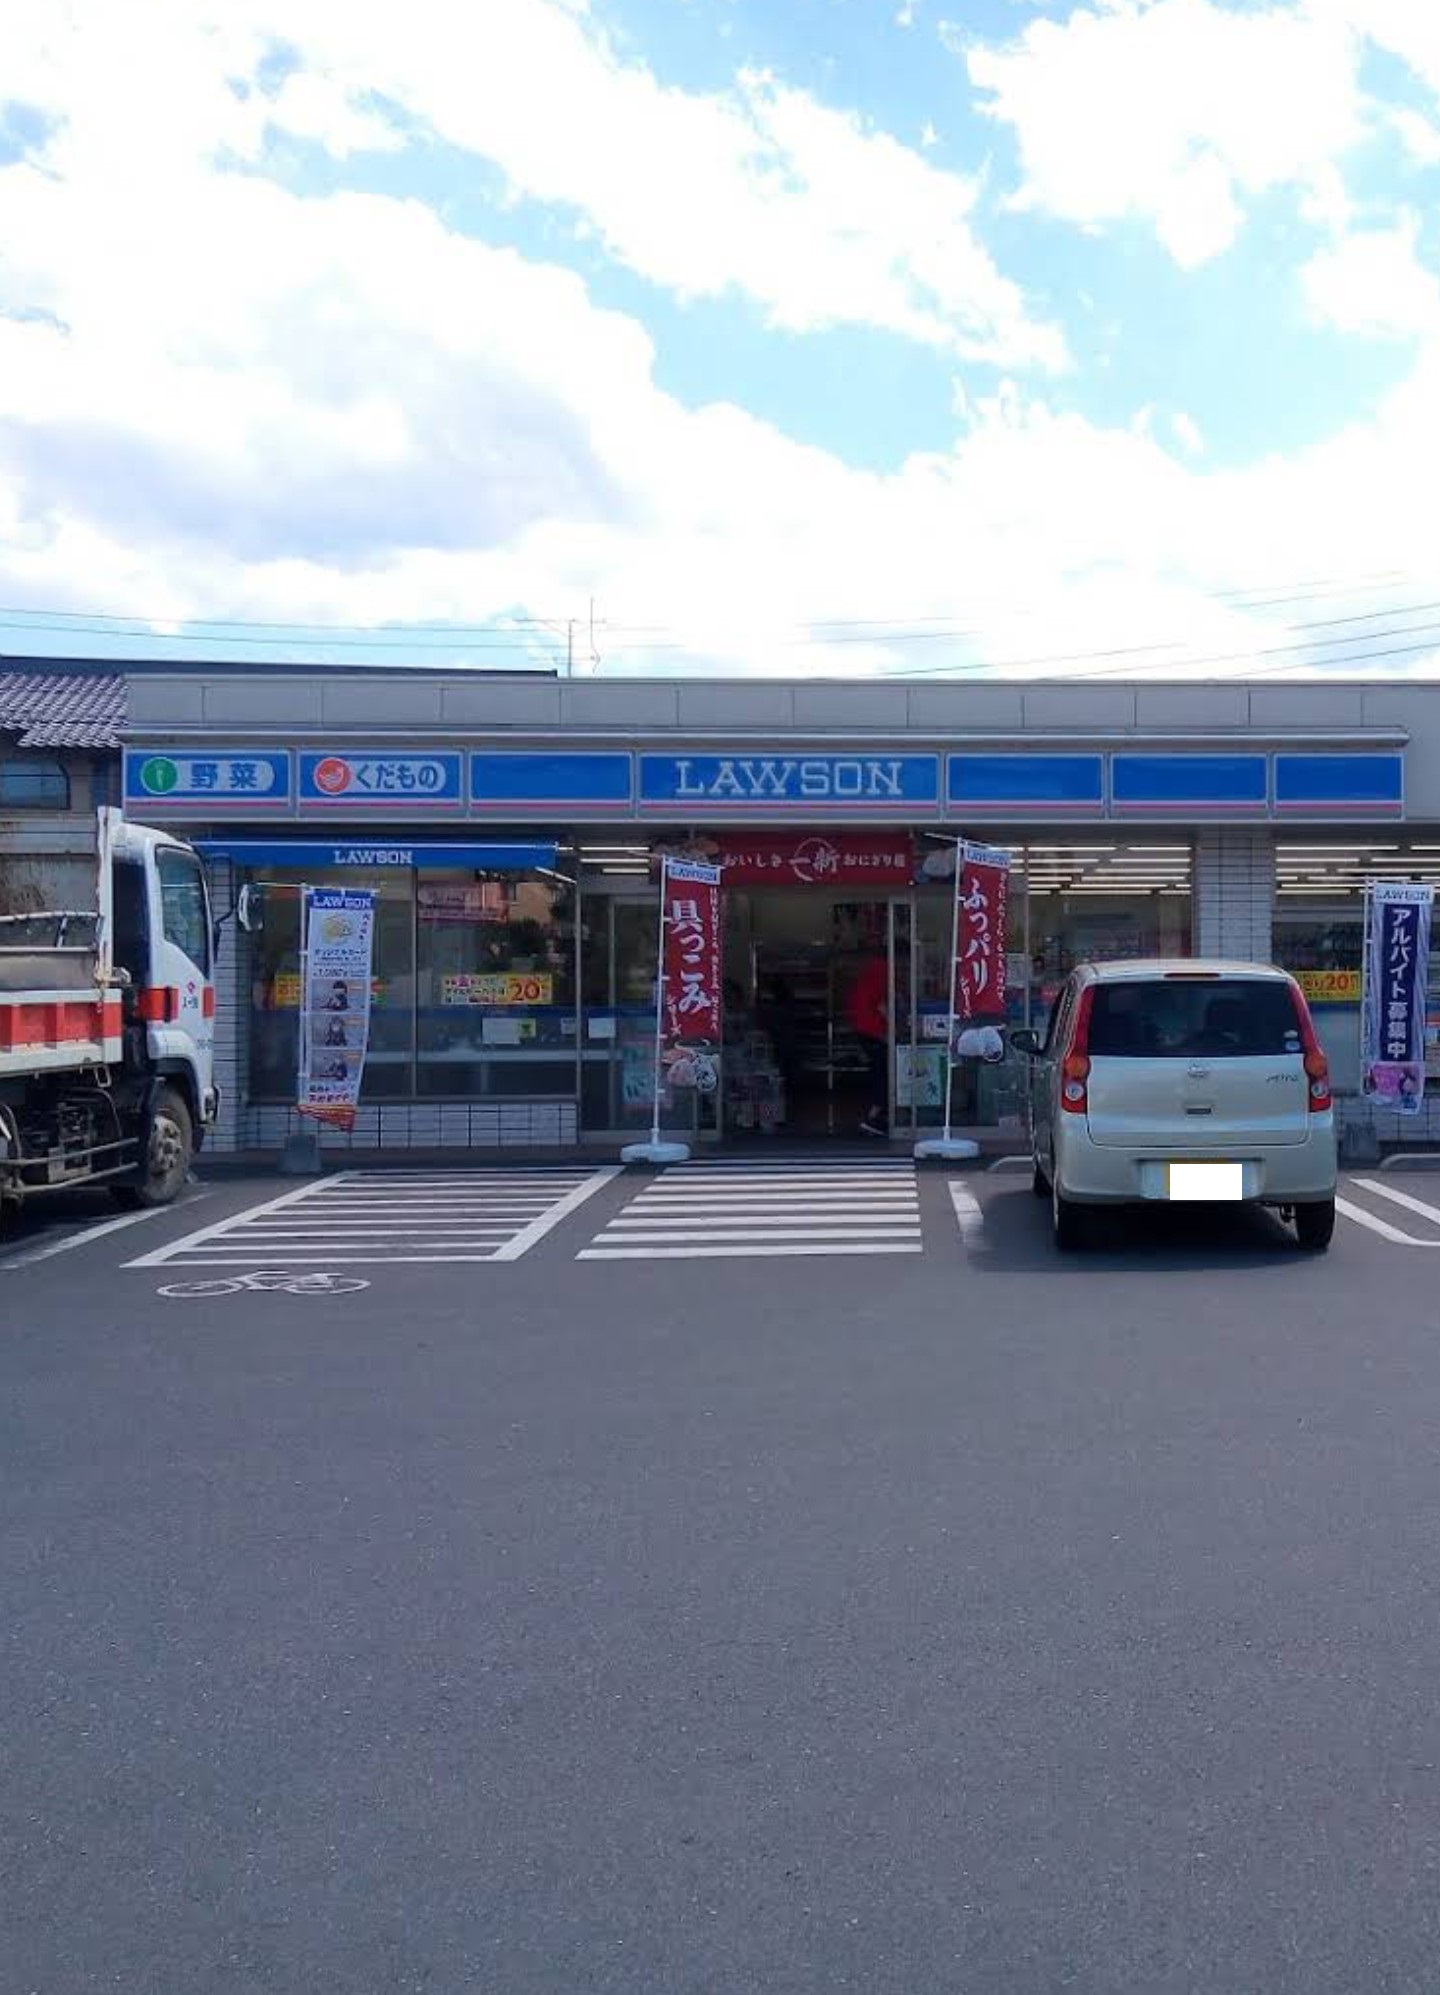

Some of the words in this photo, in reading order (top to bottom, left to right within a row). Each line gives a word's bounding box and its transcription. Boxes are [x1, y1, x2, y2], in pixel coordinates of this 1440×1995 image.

[190, 763, 258, 788] 野菜
[355, 763, 439, 788] くだもの
[675, 761, 903, 795] LAWSON
[333, 850, 413, 864] LAWSON
[313, 896, 371, 908] LAWSON
[1377, 888, 1431, 900] LAWSON
[1387, 908, 1412, 1058] アルバイト募集中
